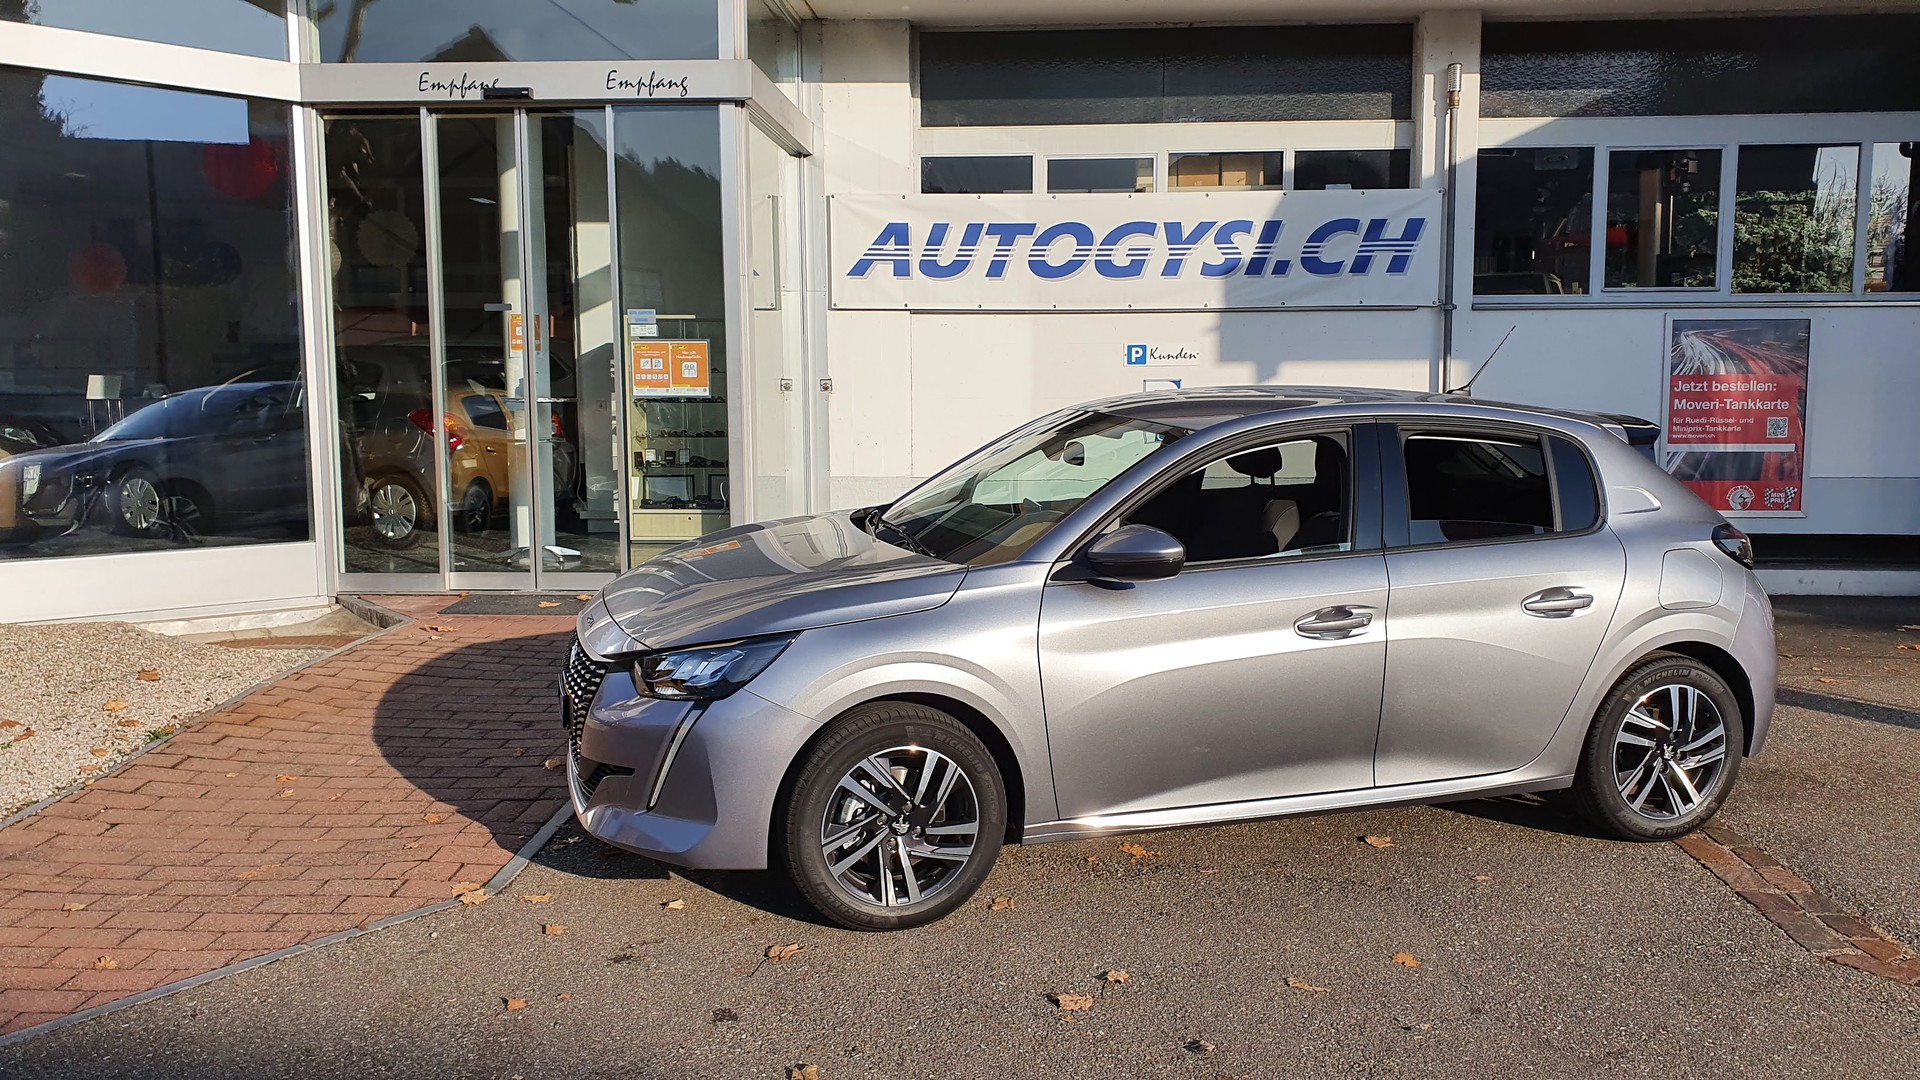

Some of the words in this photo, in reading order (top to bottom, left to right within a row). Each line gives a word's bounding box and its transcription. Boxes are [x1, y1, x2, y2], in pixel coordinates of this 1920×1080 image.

[606, 69, 688, 97] Empfang
[846, 217, 1426, 278] AUTOGYSI.CH
[1131, 347, 1144, 363] P
[1149, 347, 1197, 360] Kunden
[1674, 380, 1708, 392] Jetzt
[1712, 380, 1777, 392] bestellen:
[1673, 399, 1790, 411] Moveri-Tankkarte
[1672, 416, 1684, 424] für
[1685, 416, 1738, 424] Ruedi-Rüssel-
[1739, 416, 1754, 424] und
[1672, 425, 1742, 433] Miniprix-Tankkarte
[1643, 669, 1691, 687] MICHELIN
[934, 731, 985, 774] MICHELIN
